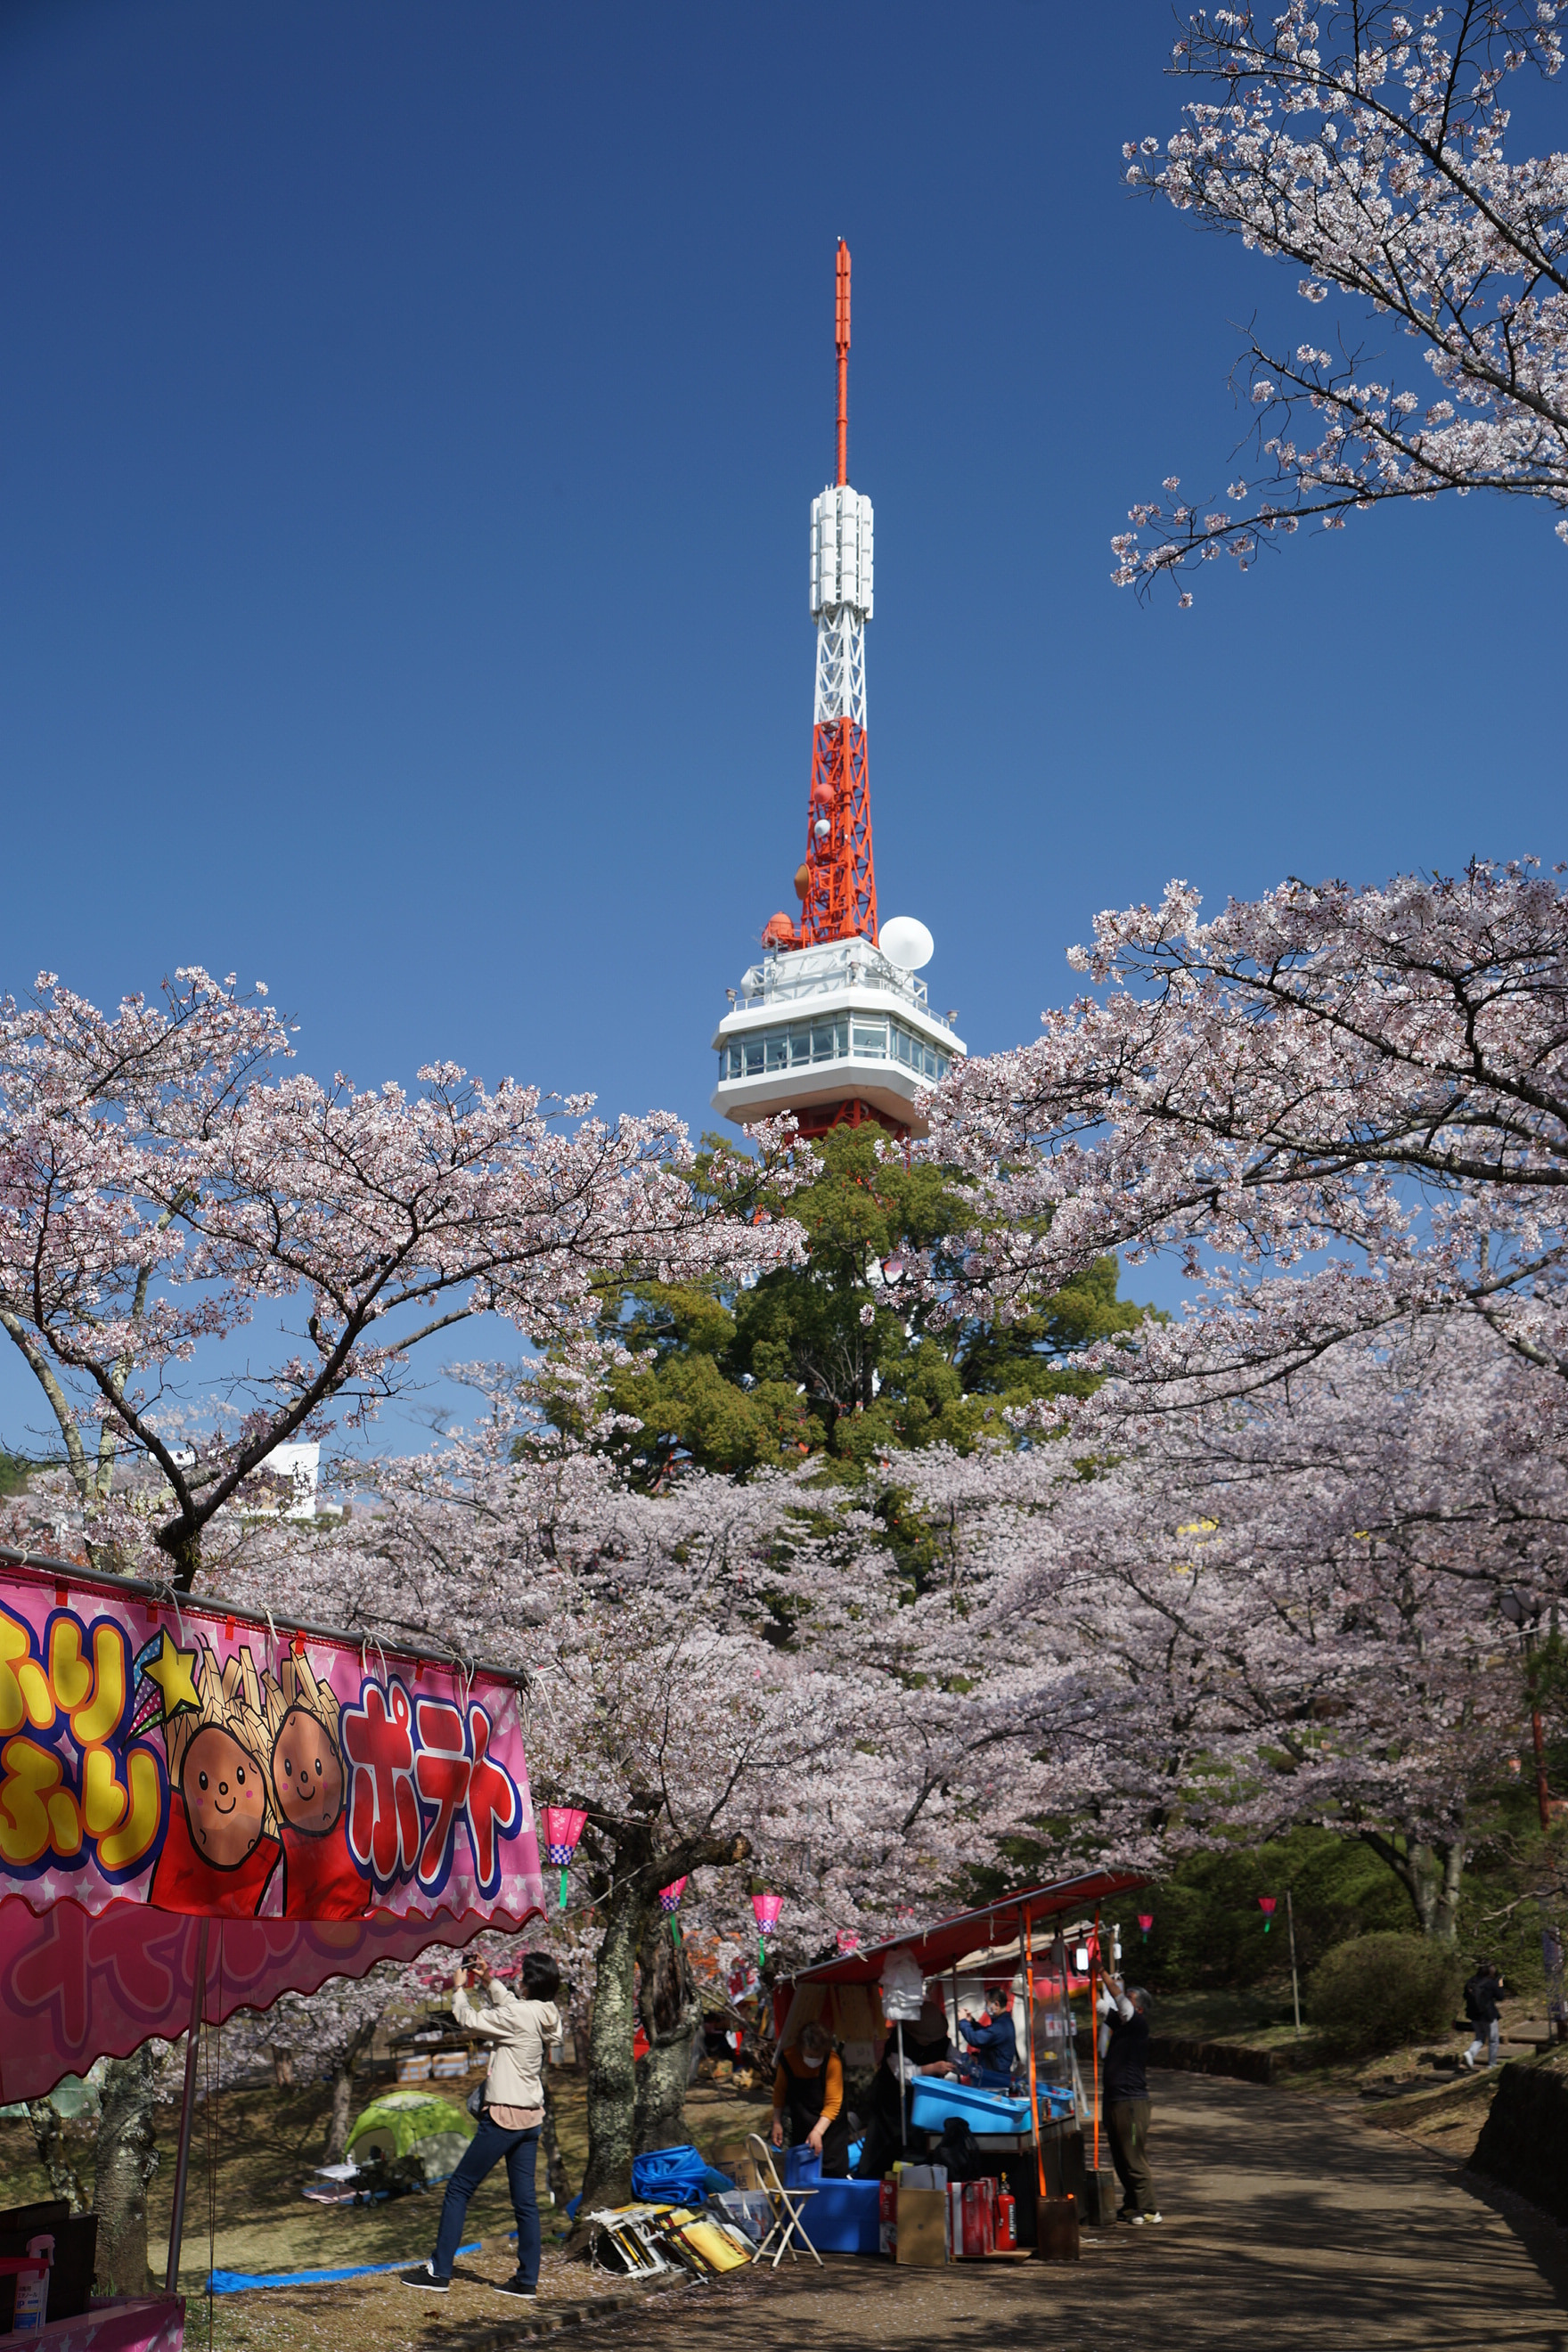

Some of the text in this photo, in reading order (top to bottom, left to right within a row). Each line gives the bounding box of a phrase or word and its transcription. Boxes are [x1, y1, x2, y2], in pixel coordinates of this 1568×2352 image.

[0, 1735, 162, 1872] ふり
[341, 1680, 517, 1889] ポテト
